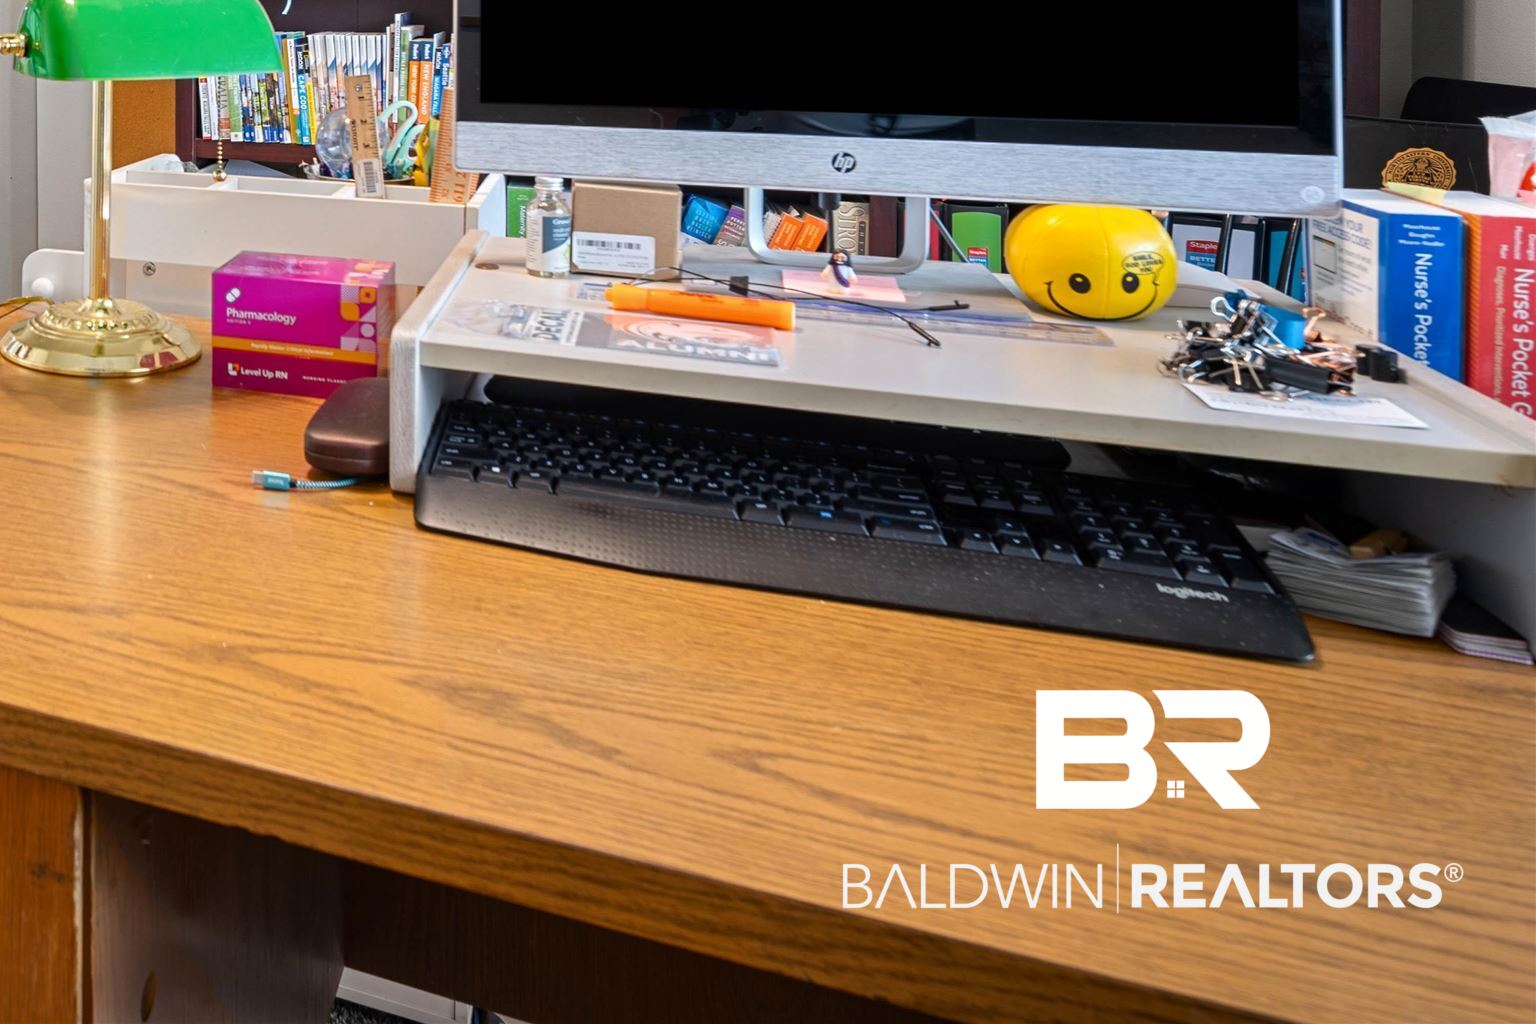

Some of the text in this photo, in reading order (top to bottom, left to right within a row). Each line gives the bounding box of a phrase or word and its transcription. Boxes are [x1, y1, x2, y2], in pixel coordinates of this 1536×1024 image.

[297, 51, 307, 110] MOON CAPE COD
[441, 62, 449, 86] Seattle
[421, 81, 430, 116] ENGLAND
[834, 152, 855, 173] hp
[1188, 240, 1218, 250] Staple
[1189, 255, 1217, 264] BETTE
[1414, 252, 1434, 310] Nurse's
[1513, 267, 1535, 333] Nurse's
[225, 307, 297, 326] Pharmacology
[1495, 306, 1507, 344] Prioritized
[615, 339, 771, 363] ALUMNI
[240, 366, 289, 380] Level Up RN
[1510, 337, 1534, 398] Pocket
[1155, 581, 1230, 604] logitech
